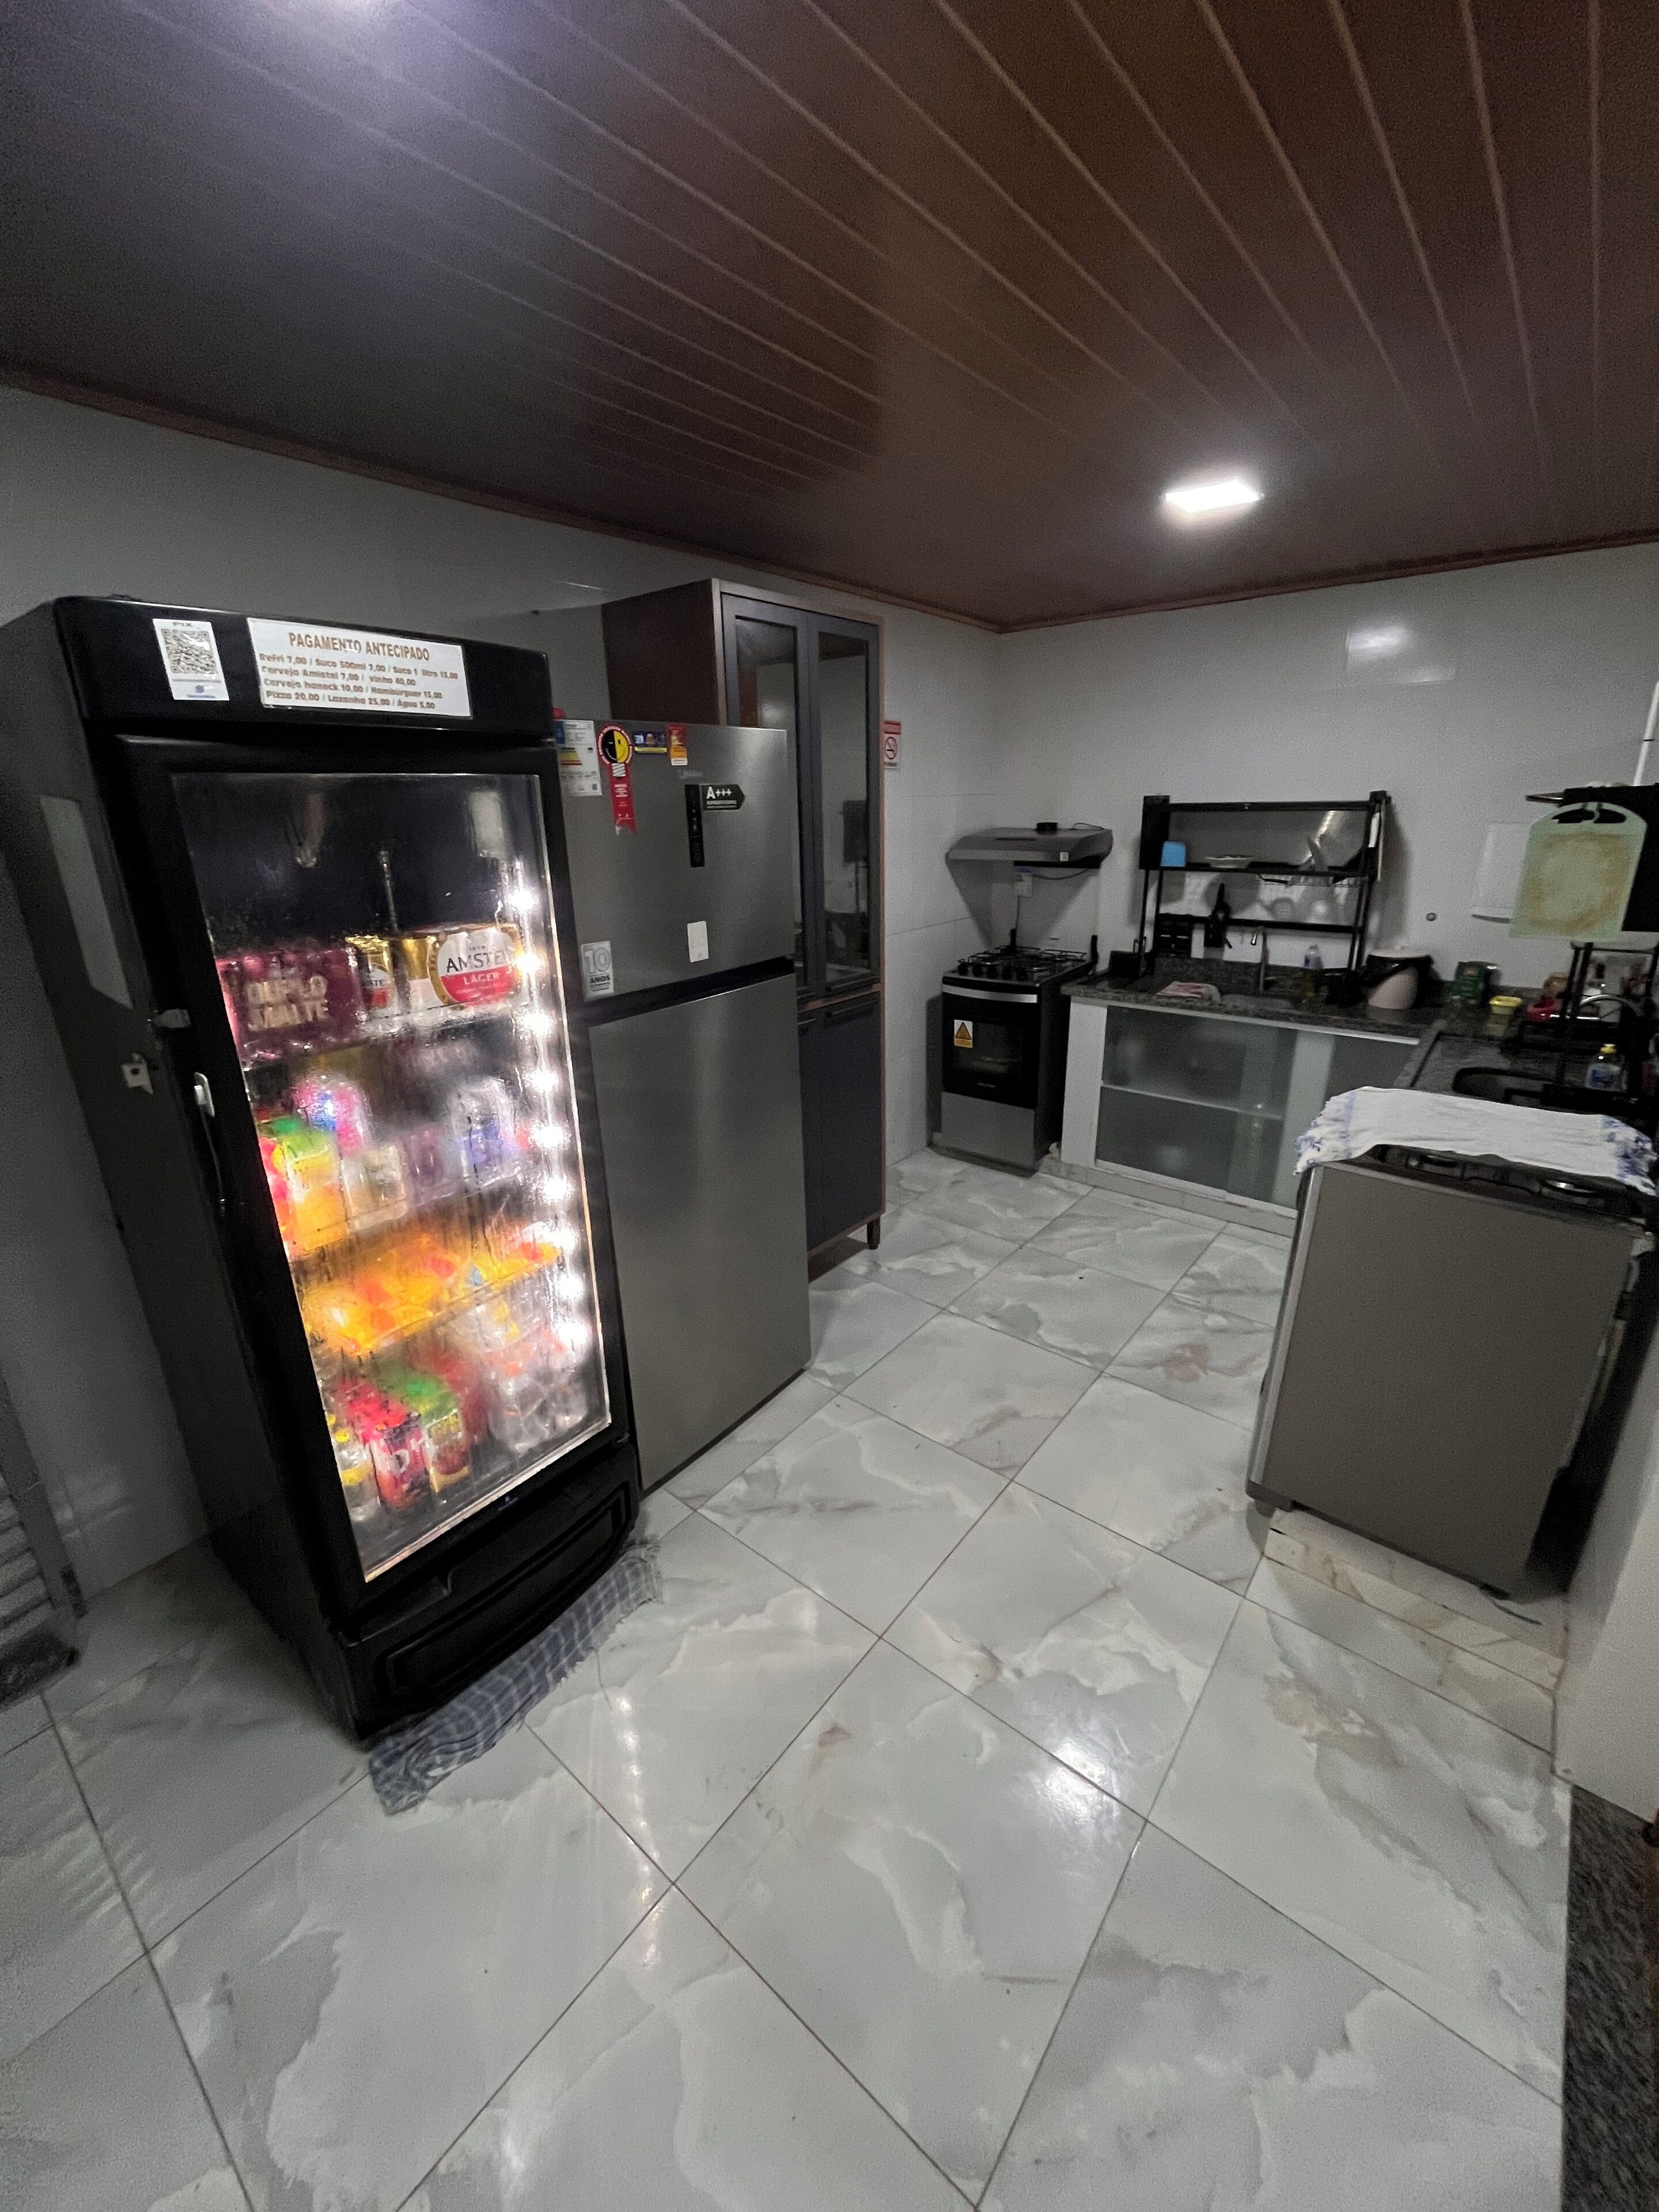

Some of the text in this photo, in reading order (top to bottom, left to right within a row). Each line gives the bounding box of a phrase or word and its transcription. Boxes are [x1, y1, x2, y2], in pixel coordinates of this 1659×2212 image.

[288, 632, 430, 661] PAGAMENTO ANTECIPADO
[262, 666, 299, 677] Cerveja
[315, 658, 338, 668] Suco
[393, 666, 412, 675] Suco
[264, 678, 301, 689] Cerveja
[266, 691, 292, 699] Pizza
[706, 786, 732, 799] A+++
[585, 948, 611, 973] 10
[463, 971, 500, 985] LAGER
